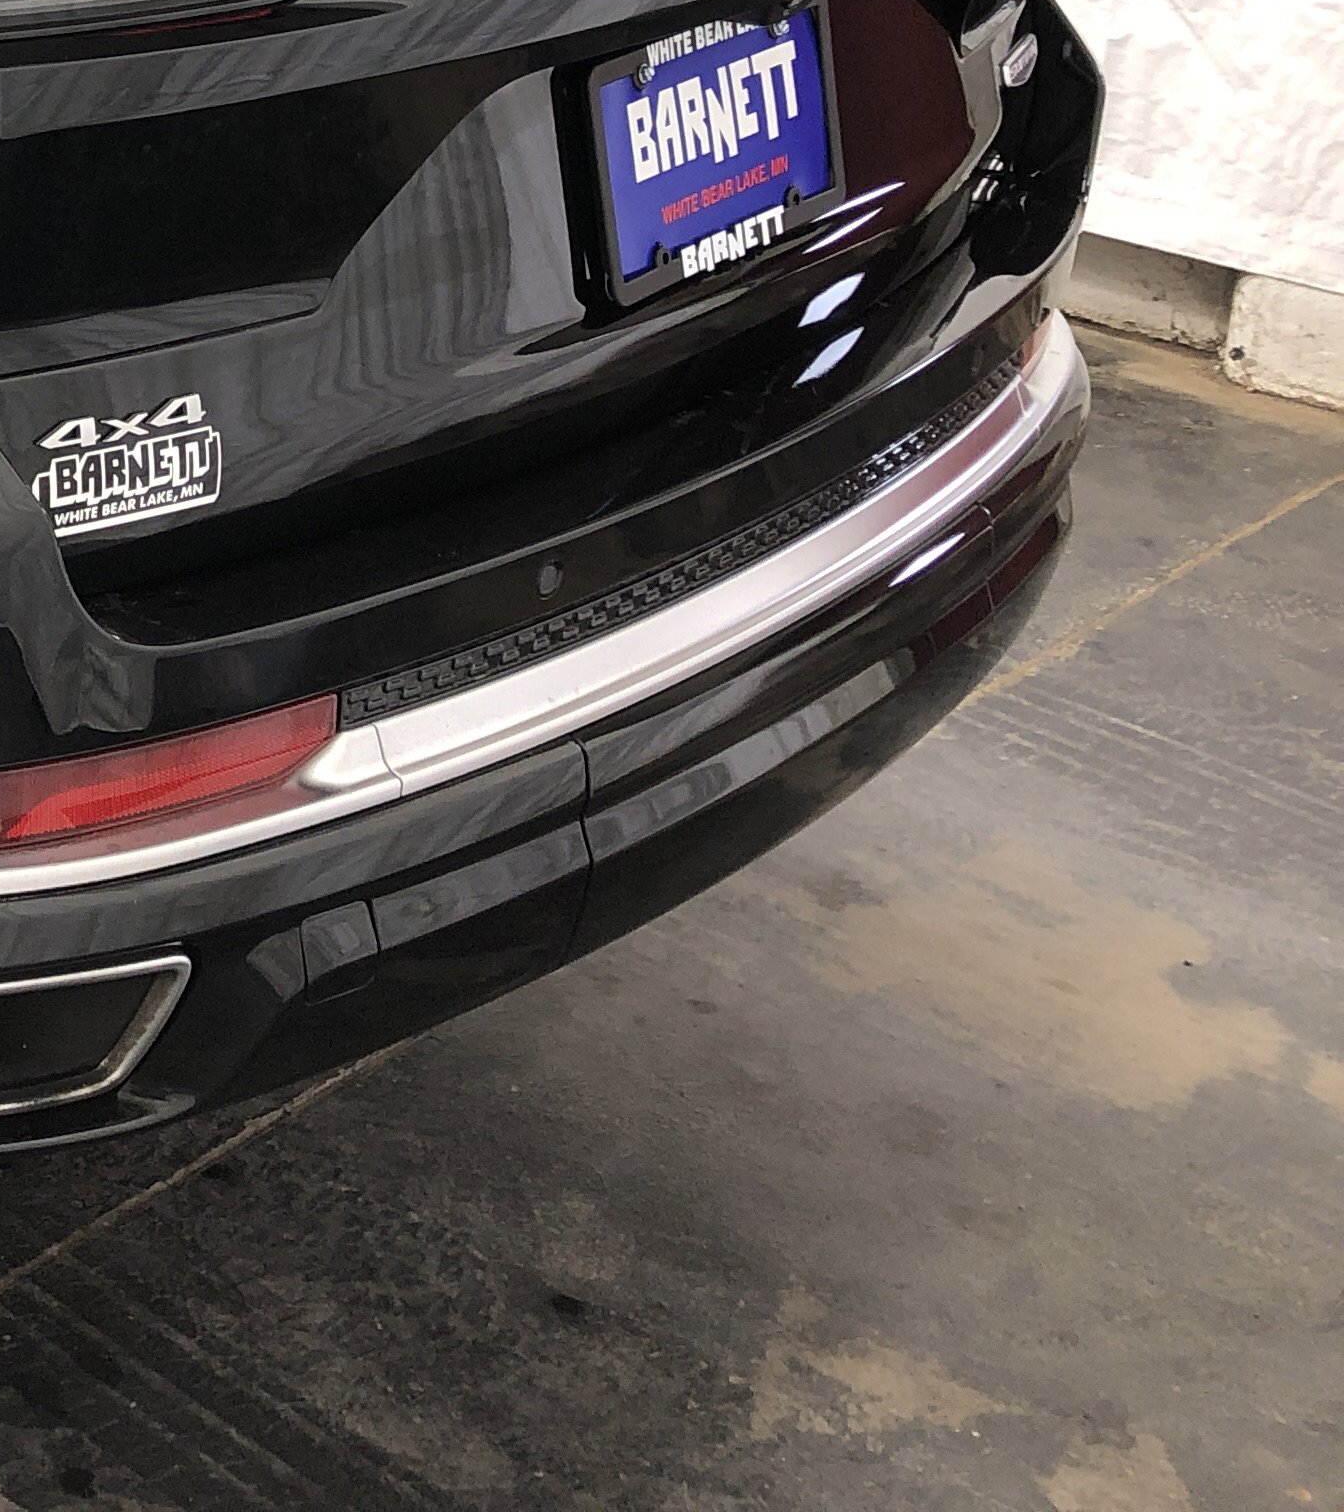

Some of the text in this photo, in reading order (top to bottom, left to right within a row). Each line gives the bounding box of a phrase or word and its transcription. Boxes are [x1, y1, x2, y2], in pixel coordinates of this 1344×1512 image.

[646, 30, 693, 68] WHITE
[694, 20, 734, 50] BEAR
[626, 40, 799, 184] BARNETT
[660, 192, 700, 225] WHITE
[700, 176, 734, 209] BEAR
[770, 153, 790, 178] MN
[680, 204, 786, 279] BARNETT
[34, 392, 206, 450] 4x4
[52, 429, 211, 505] BARNETT
[54, 482, 204, 526] WHITE BEAR LAKE, MN
